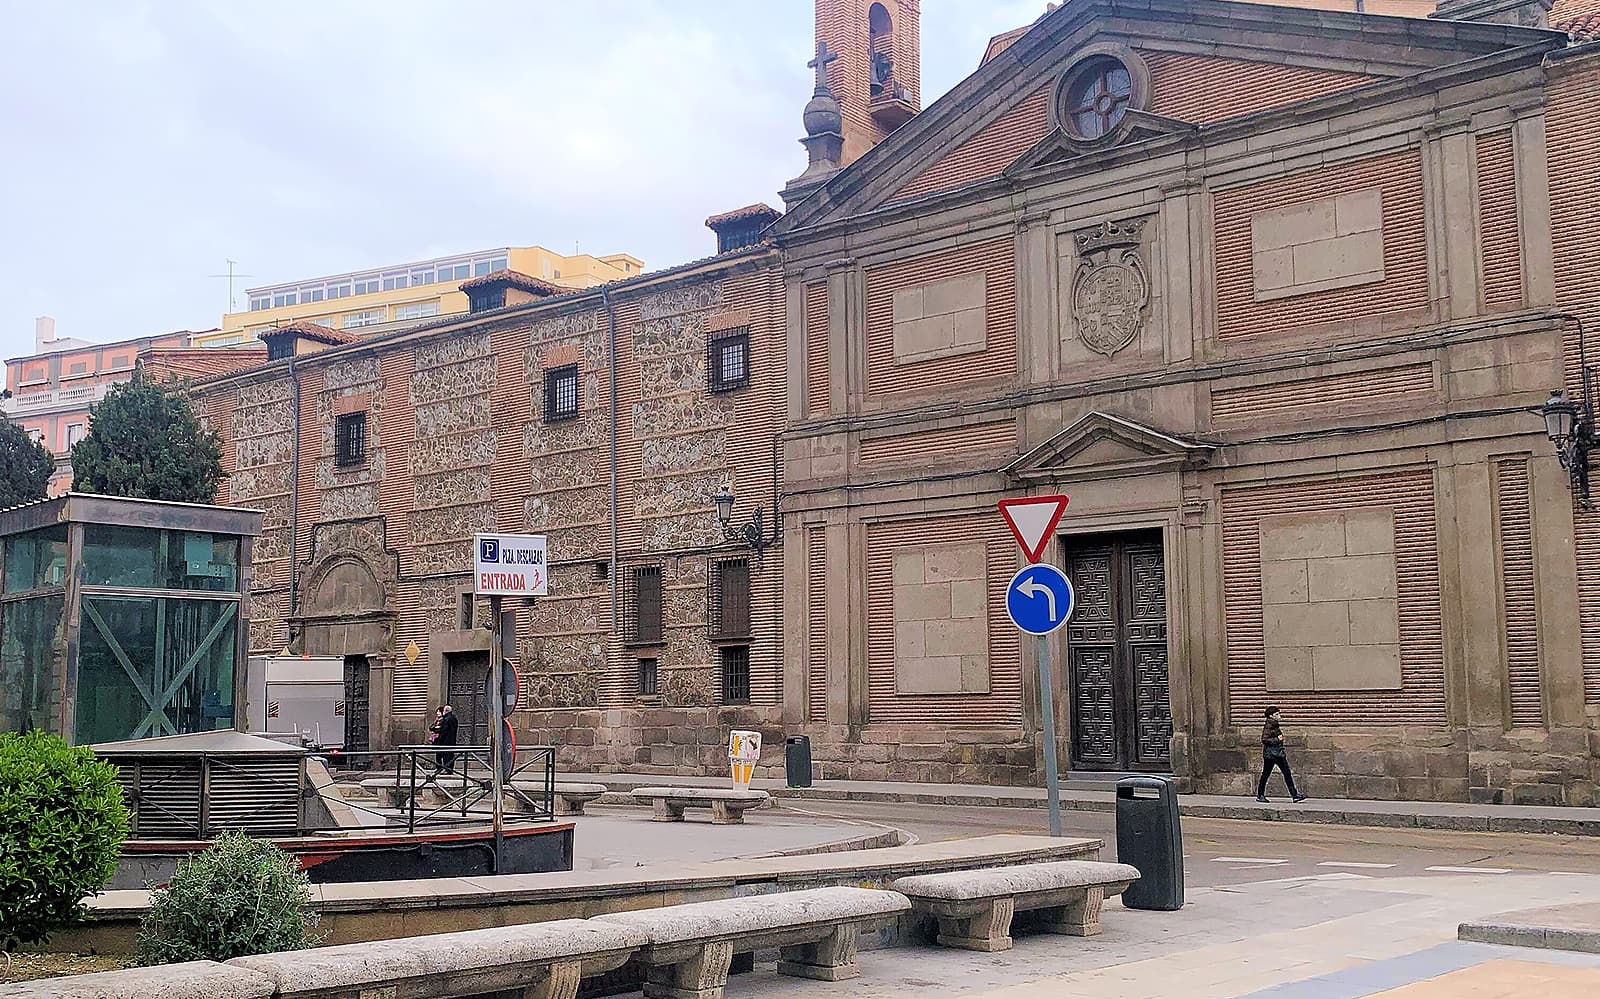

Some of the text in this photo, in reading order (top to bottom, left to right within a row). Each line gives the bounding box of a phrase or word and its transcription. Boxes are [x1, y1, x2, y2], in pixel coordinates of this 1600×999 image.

[484, 542, 494, 558] P
[517, 549, 543, 565] DESCALZAS
[480, 573, 526, 590] ENTRADA
